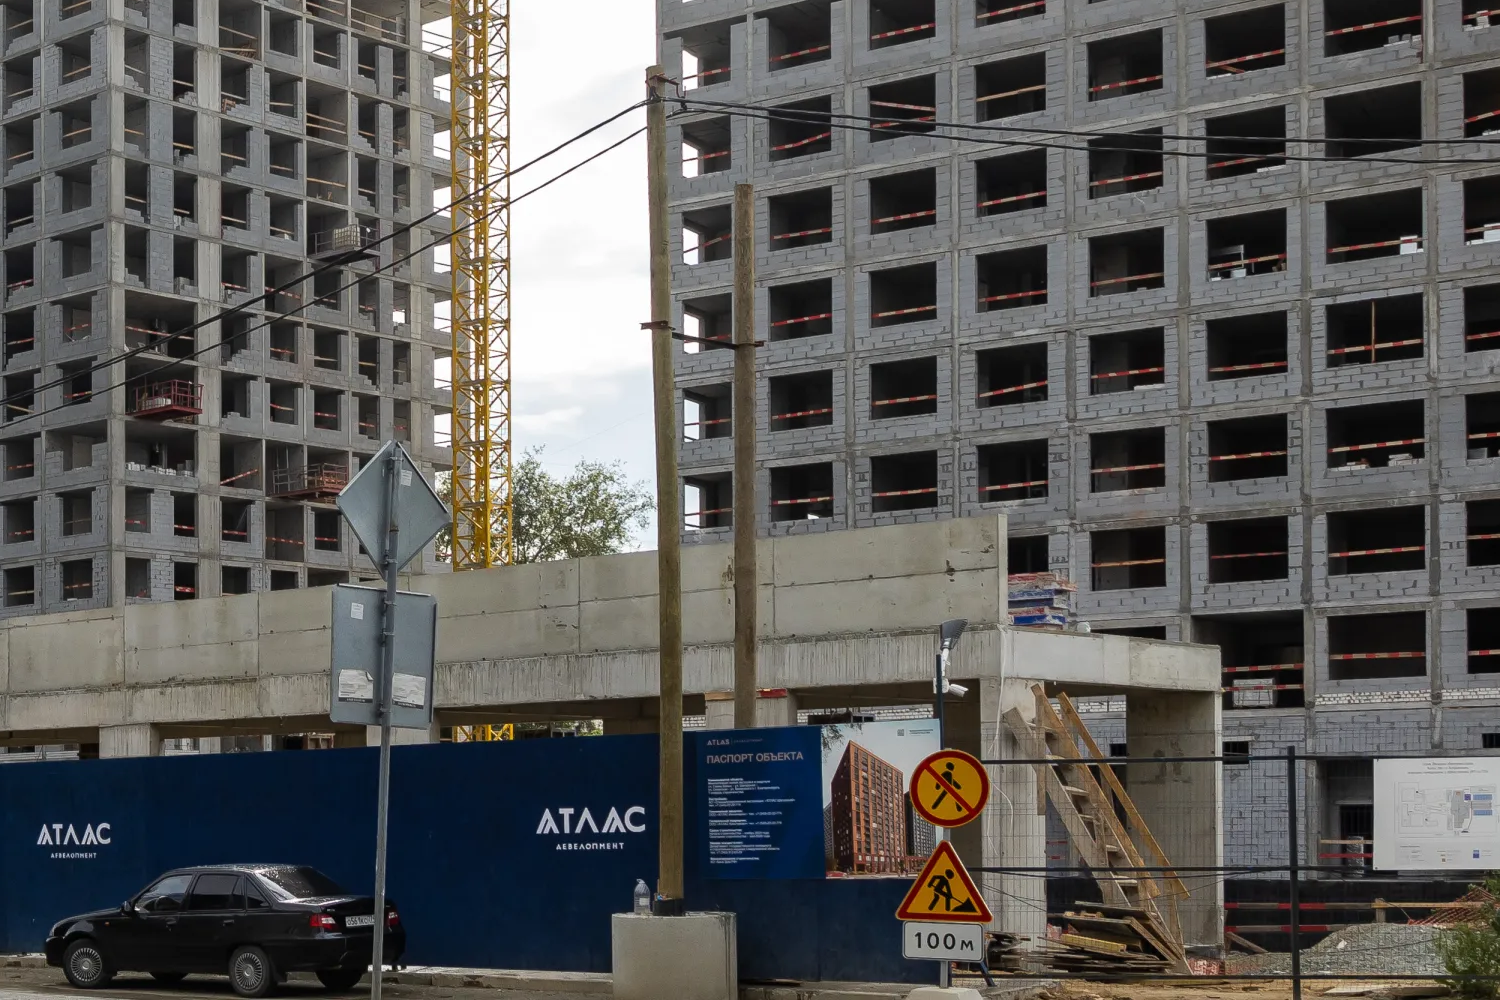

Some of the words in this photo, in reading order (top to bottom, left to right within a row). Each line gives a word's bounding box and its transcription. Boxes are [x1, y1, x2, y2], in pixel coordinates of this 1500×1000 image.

[707, 753, 753, 764] ПАСПОРТ
[756, 751, 804, 762] ОБЪЕКТА
[536, 806, 646, 834] АТЛАС
[36, 822, 111, 845] АТЛАС
[556, 842, 625, 850] ДЕВЕЛОПМЕНТ
